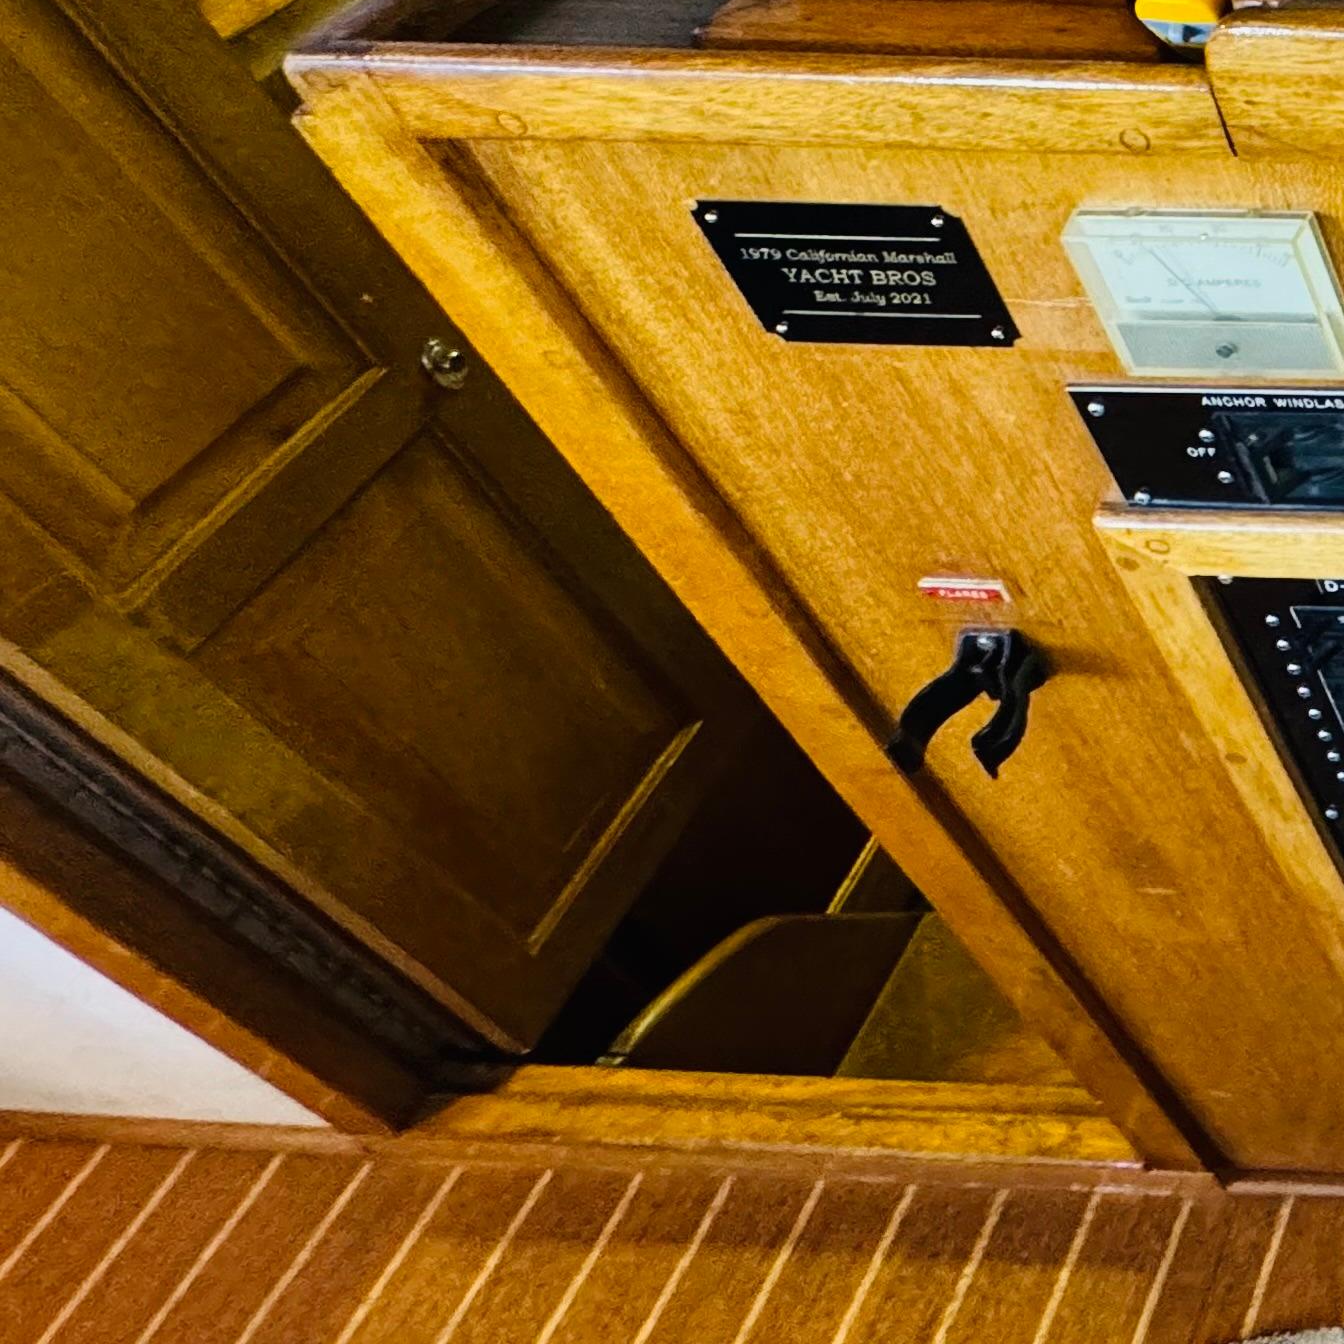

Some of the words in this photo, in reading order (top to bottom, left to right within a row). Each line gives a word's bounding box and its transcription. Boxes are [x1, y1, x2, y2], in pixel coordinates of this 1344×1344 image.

[740, 247, 782, 261] 1979
[785, 248, 880, 265] Californian
[883, 250, 958, 265] Marshall
[780, 267, 863, 285] YACHT
[871, 269, 937, 287] BROS
[813, 289, 848, 303] Est.
[850, 290, 886, 306] July
[889, 291, 933, 305] 2021
[1201, 396, 1267, 408] ANCHOR
[1186, 446, 1217, 458] OFF
